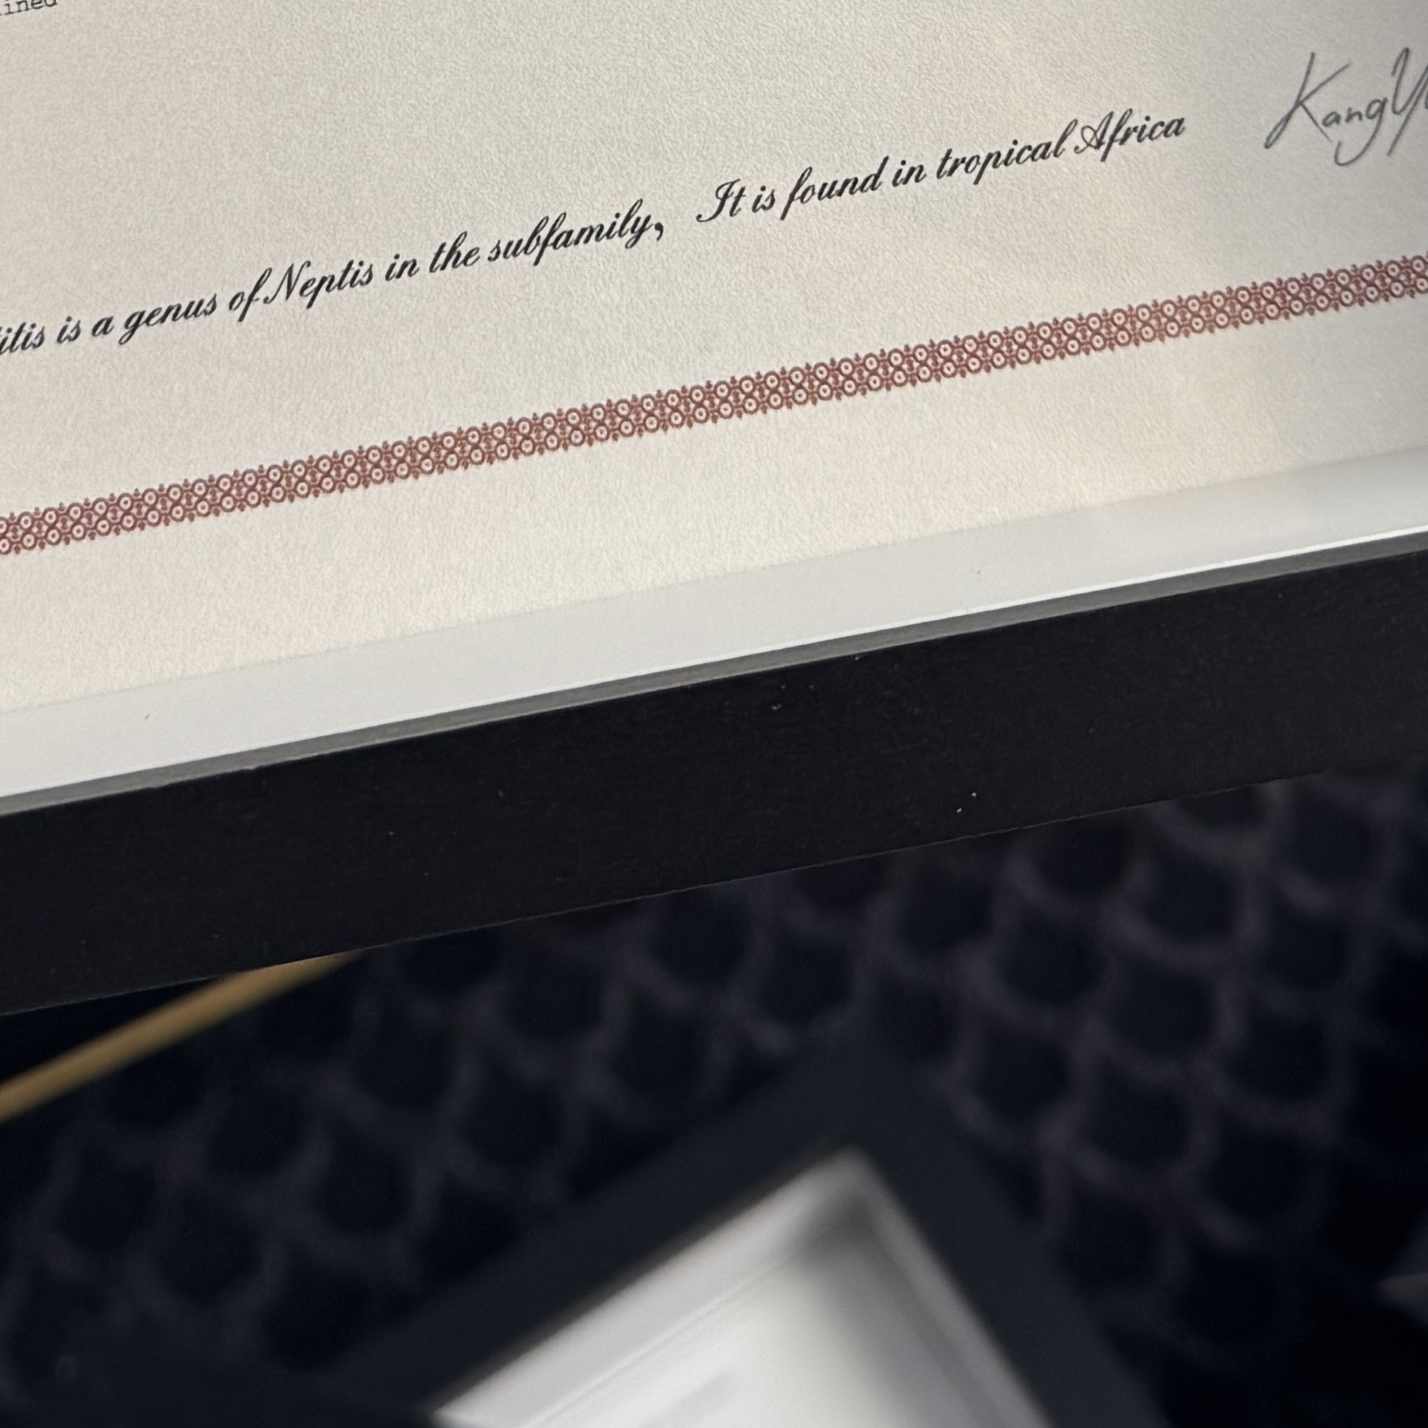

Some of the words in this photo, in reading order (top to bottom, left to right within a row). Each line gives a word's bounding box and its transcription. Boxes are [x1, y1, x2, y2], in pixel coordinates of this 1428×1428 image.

[55, 315, 82, 346] is
[90, 315, 115, 339] a
[117, 292, 218, 347] genus
[227, 266, 271, 324] of
[262, 258, 374, 311] Neptis
[384, 252, 421, 283] in
[428, 230, 481, 274] the
[486, 197, 665, 268] subfamily,
[695, 177, 747, 224] It
[750, 184, 777, 214] is
[778, 154, 887, 222] found
[891, 159, 928, 188] in
[935, 118, 1079, 186] tropical
[1073, 107, 1187, 164] Africa
